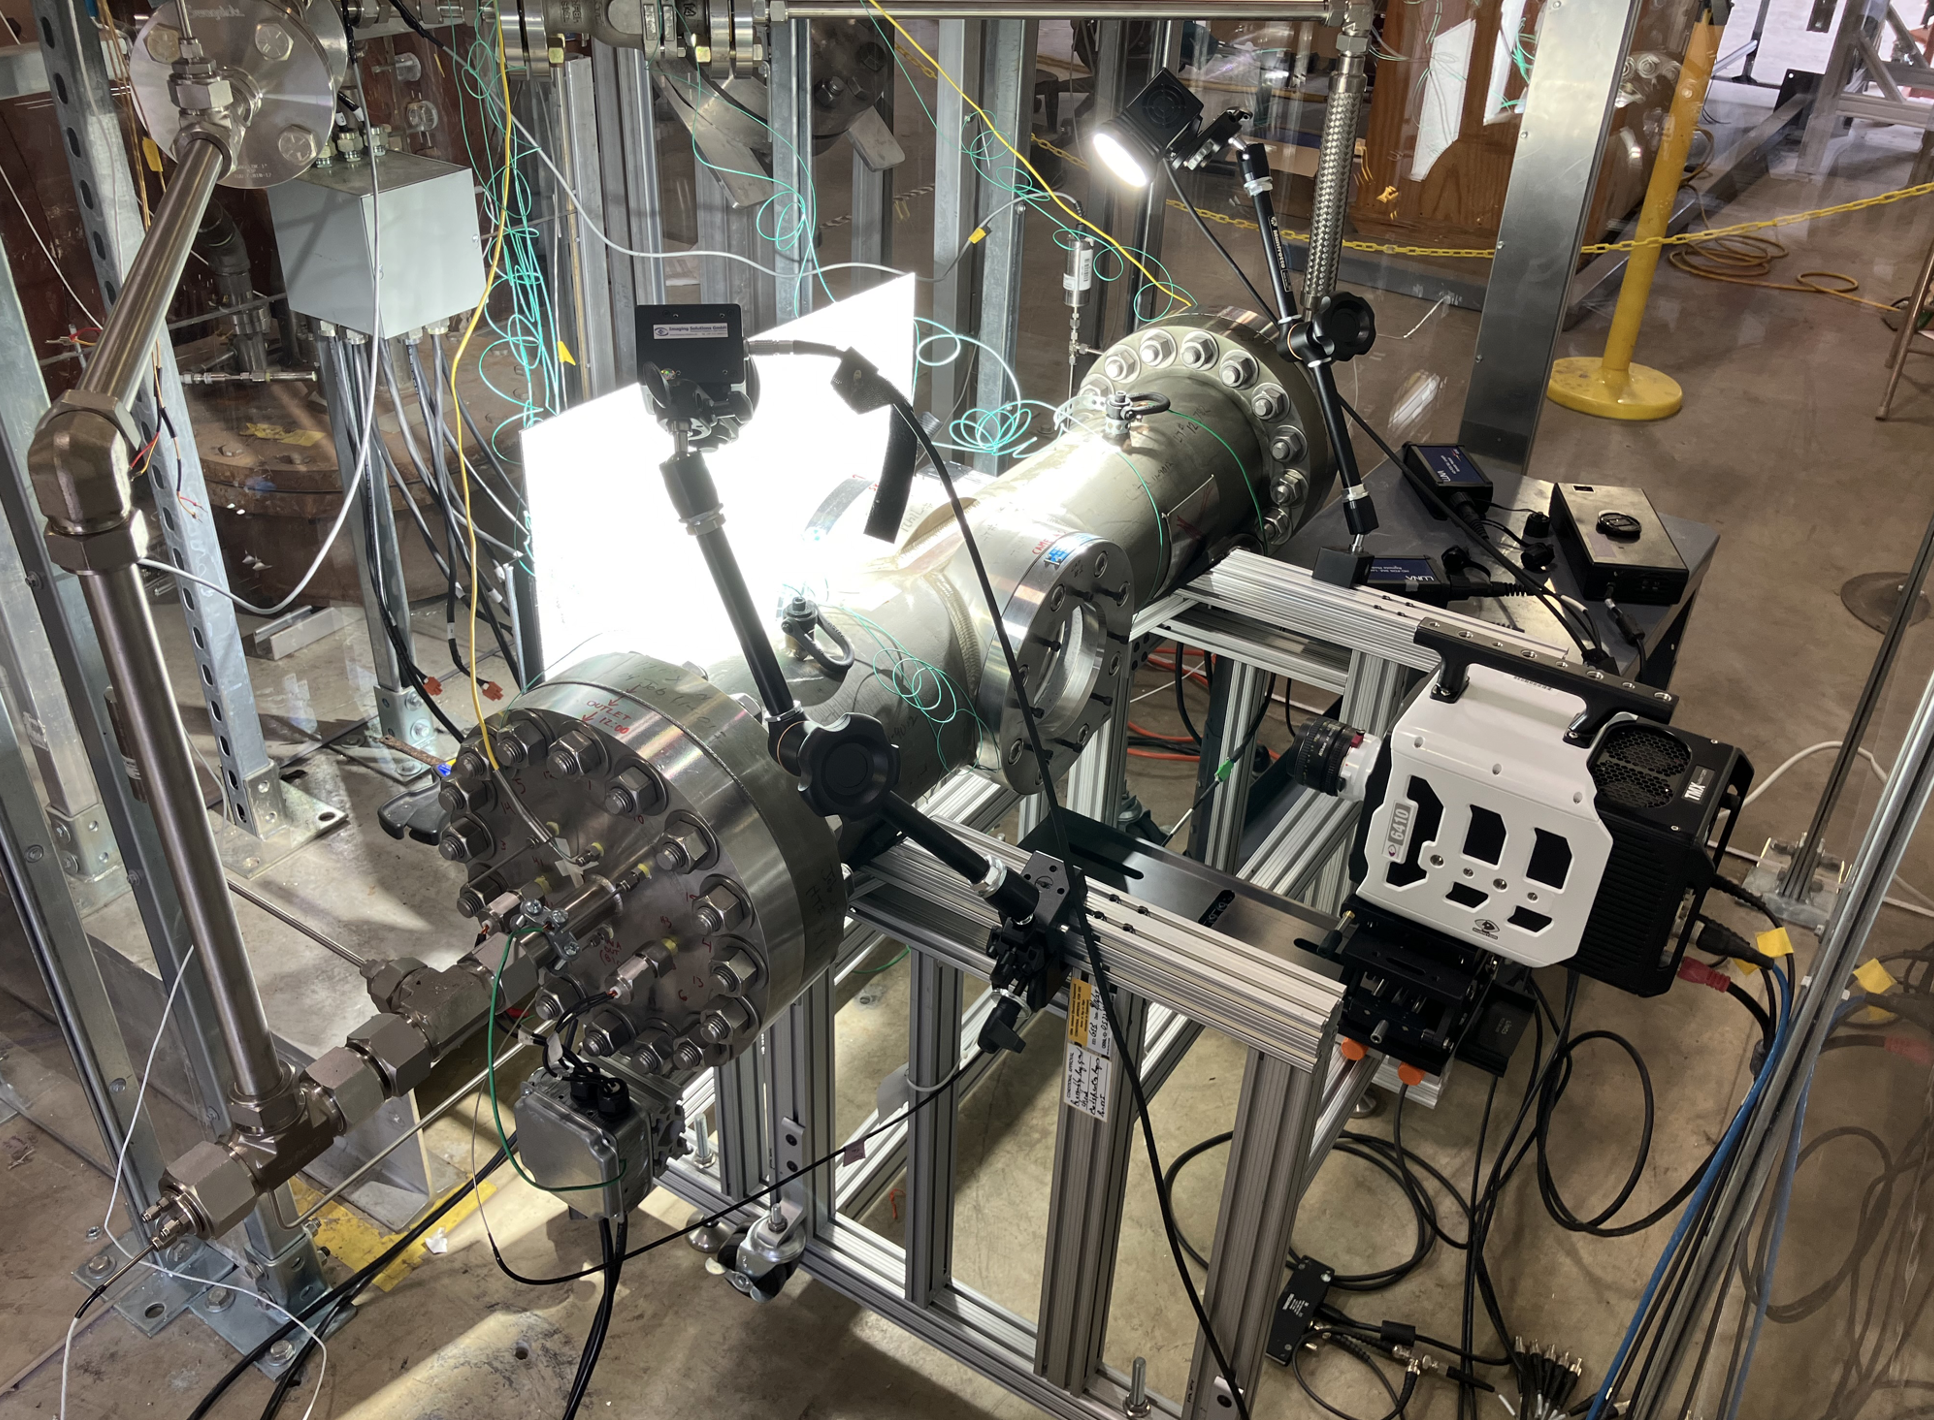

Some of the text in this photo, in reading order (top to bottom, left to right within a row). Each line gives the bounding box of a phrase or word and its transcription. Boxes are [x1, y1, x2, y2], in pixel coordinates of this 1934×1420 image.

[587, 699, 632, 721] OUTLET
[599, 716, 630, 735] 12:00
[1684, 781, 1706, 801] TMX
[1390, 808, 1409, 841] 6410
